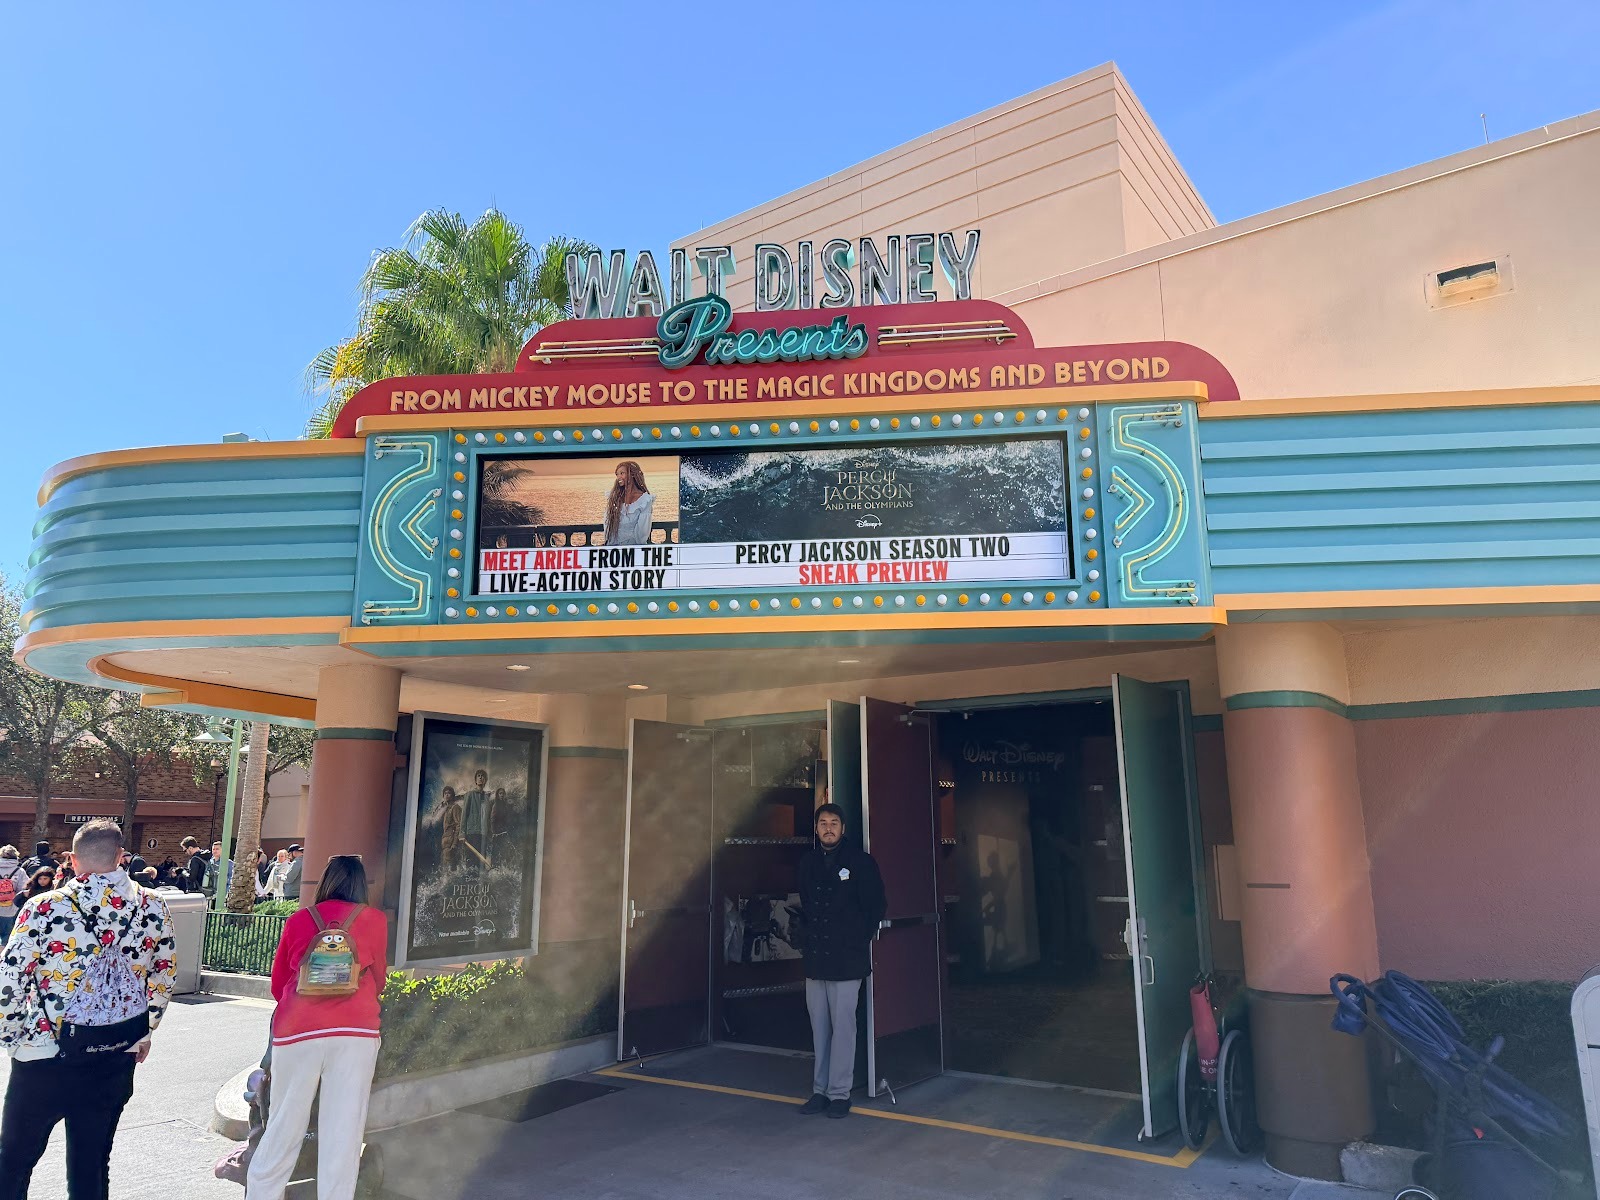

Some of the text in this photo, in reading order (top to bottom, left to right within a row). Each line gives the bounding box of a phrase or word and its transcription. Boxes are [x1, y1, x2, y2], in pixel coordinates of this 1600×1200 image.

[566, 229, 981, 320] WALT DISNEY
[656, 292, 870, 370] Presents
[390, 356, 1171, 412] FROM MICKEY MOUSE TO THE MAGIC KINGDOMS AND BEYOND
[837, 469, 897, 485] PERCY
[821, 483, 914, 505] JACKSON
[825, 500, 914, 511] AND THE OLYMPIANS
[483, 546, 673, 571] MEET ARIEL FROM THE
[735, 535, 1010, 565] PERCY JACKSON SEASON TWO
[490, 568, 666, 593] LIVE-ACTION STORY
[799, 560, 949, 586] SNEAK PREVIEW
[963, 740, 1065, 771] Walt Disney
[440, 895, 498, 914] JACKSON
